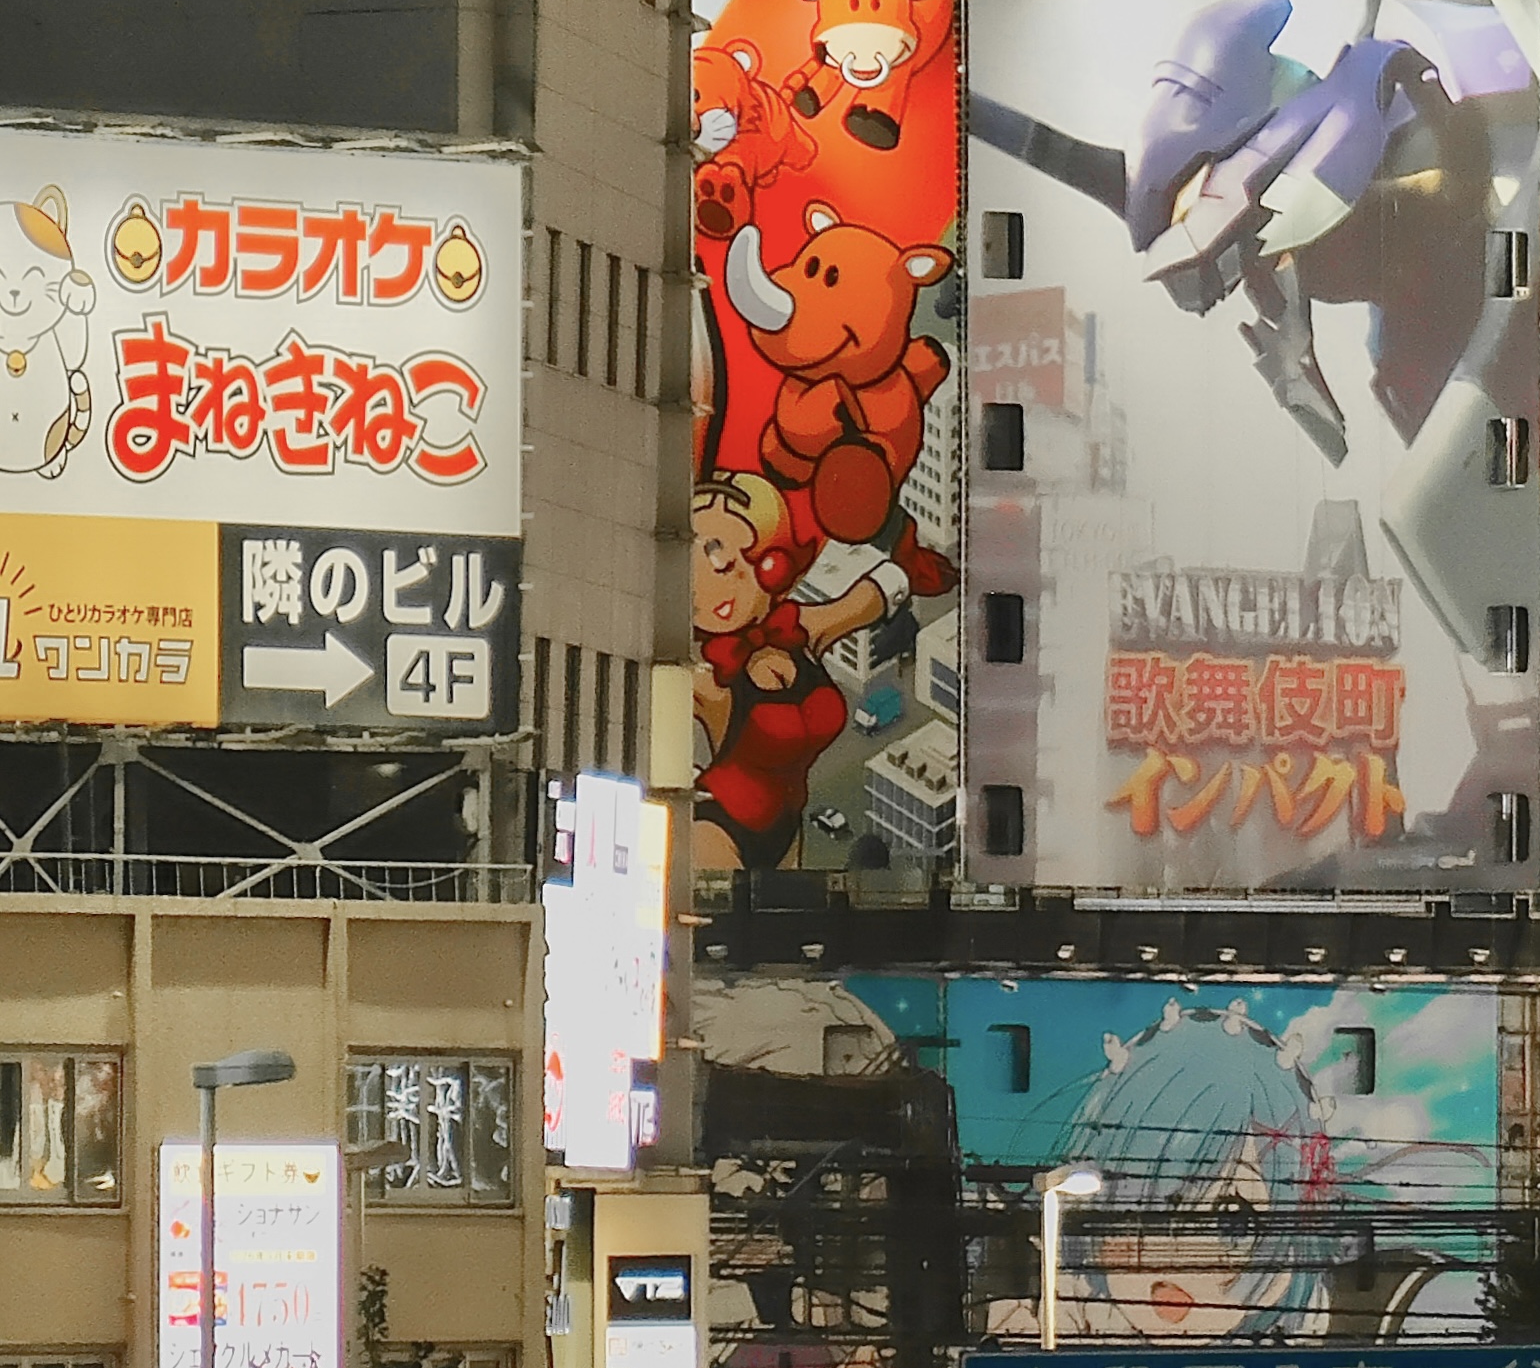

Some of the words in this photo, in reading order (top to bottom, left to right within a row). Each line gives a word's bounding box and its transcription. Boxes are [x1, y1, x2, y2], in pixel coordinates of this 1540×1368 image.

[166, 198, 433, 299] カラオケ
[111, 323, 488, 478] まねきねこ
[49, 603, 194, 629] ひとりカラオケ専門店
[241, 539, 503, 632] 隣のビル
[33, 634, 193, 685] ワンカラ
[399, 649, 481, 706] 4F
[1106, 654, 1406, 750] 歌舞伎町
[1105, 750, 1407, 837] インパクト
[173, 1160, 299, 1185] 飲ギフト券
